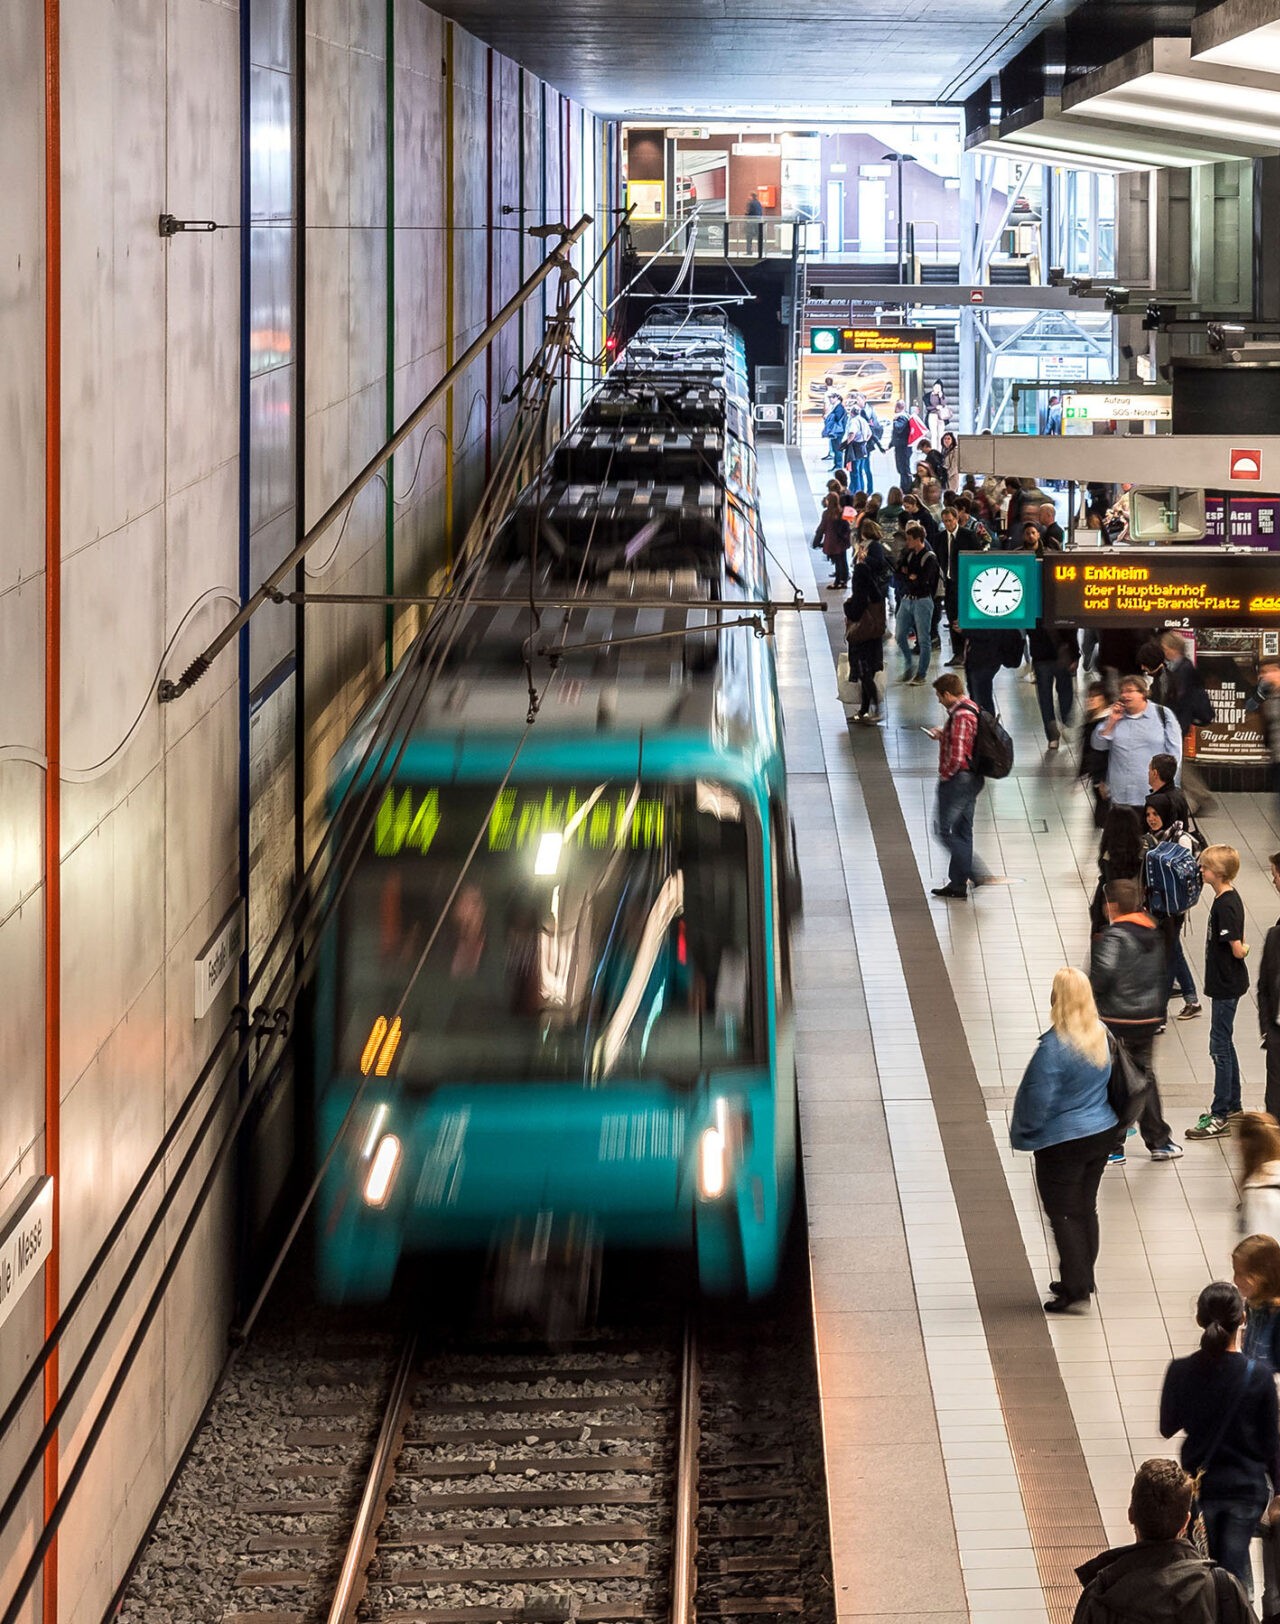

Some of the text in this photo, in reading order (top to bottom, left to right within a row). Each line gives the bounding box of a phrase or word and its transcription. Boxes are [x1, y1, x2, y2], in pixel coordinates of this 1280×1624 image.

[1104, 397, 1131, 405] Aufzug
[1055, 566, 1148, 580] U4 Enkheim
[1084, 584, 1207, 598] über Hauptbahnhof
[1084, 598, 1240, 611] und Willy-Brandt-Platz
[1164, 618, 1190, 627] Gleis 2
[1200, 730, 1230, 743] Tiger
[18, 1217, 42, 1277] Messe
